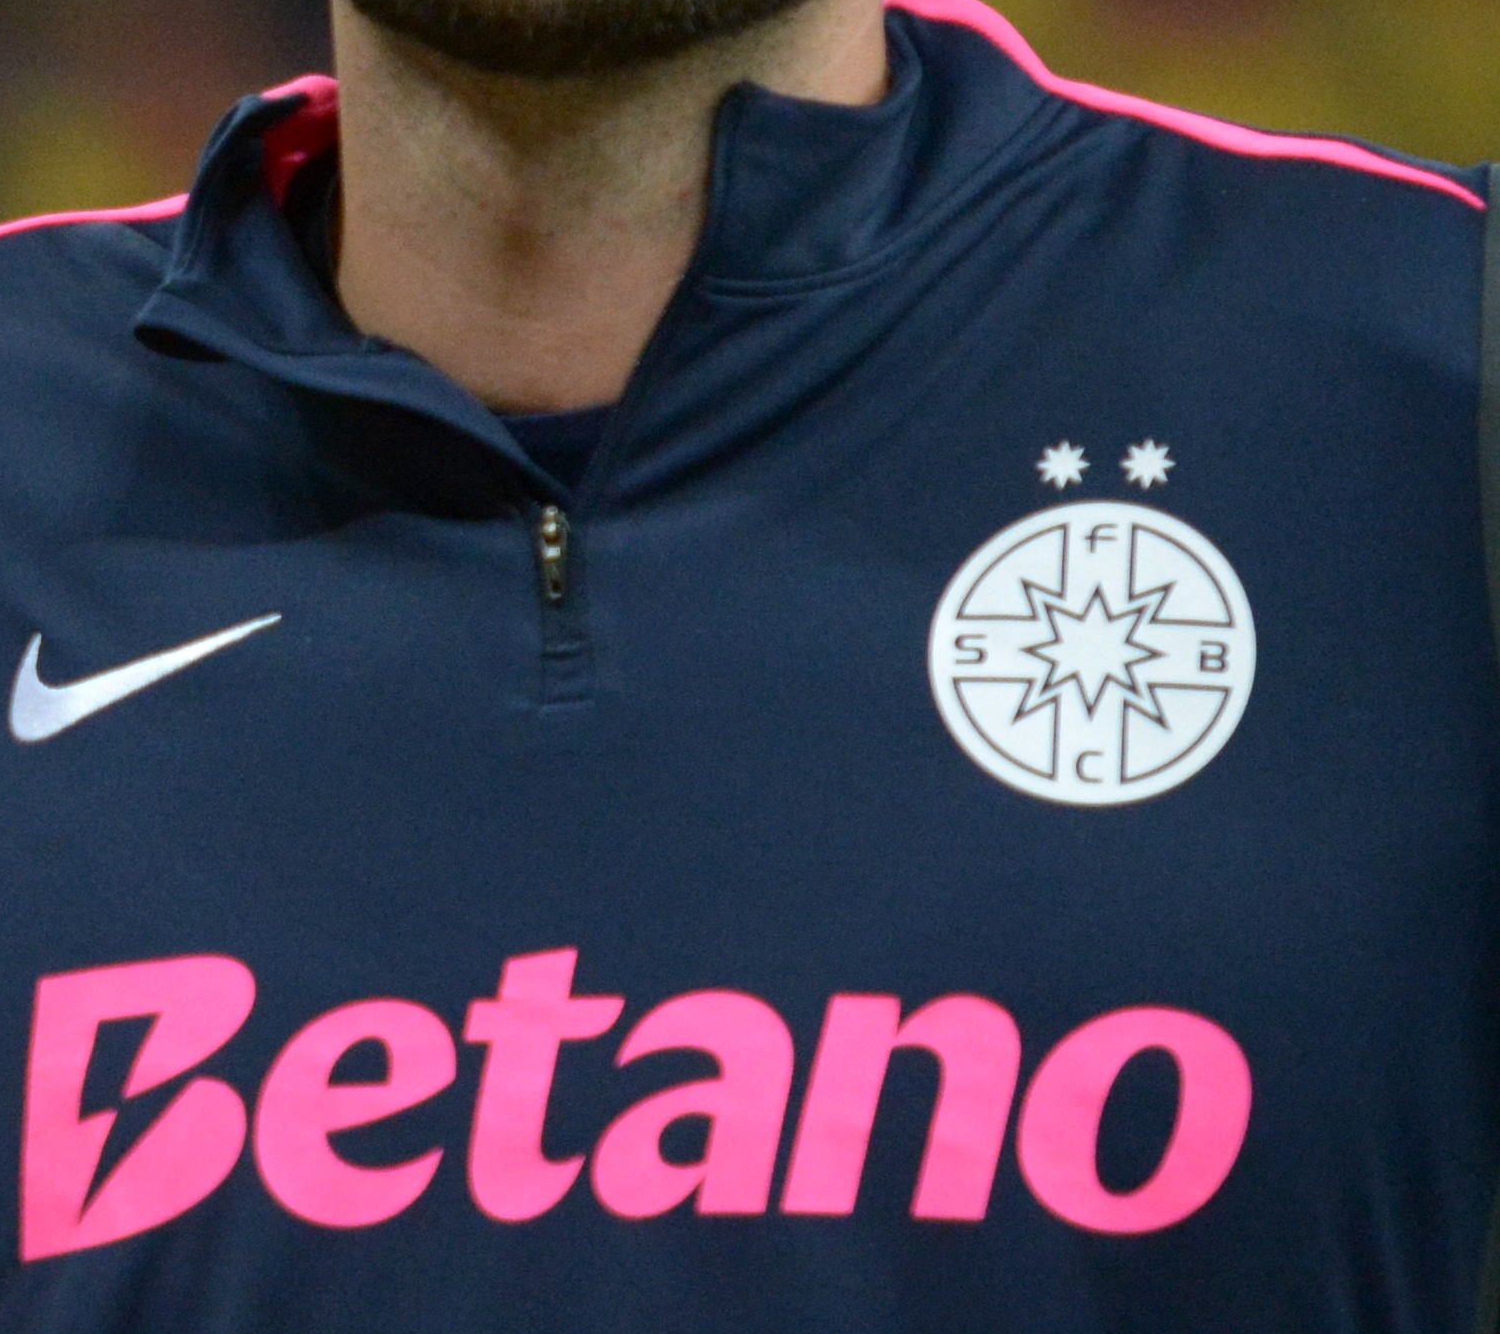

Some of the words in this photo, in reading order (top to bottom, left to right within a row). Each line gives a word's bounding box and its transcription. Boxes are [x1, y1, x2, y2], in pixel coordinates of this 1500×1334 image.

[954, 633, 988, 665] S
[1199, 640, 1230, 673] B
[1074, 749, 1104, 784] C
[19, 947, 1252, 1262] Betano
